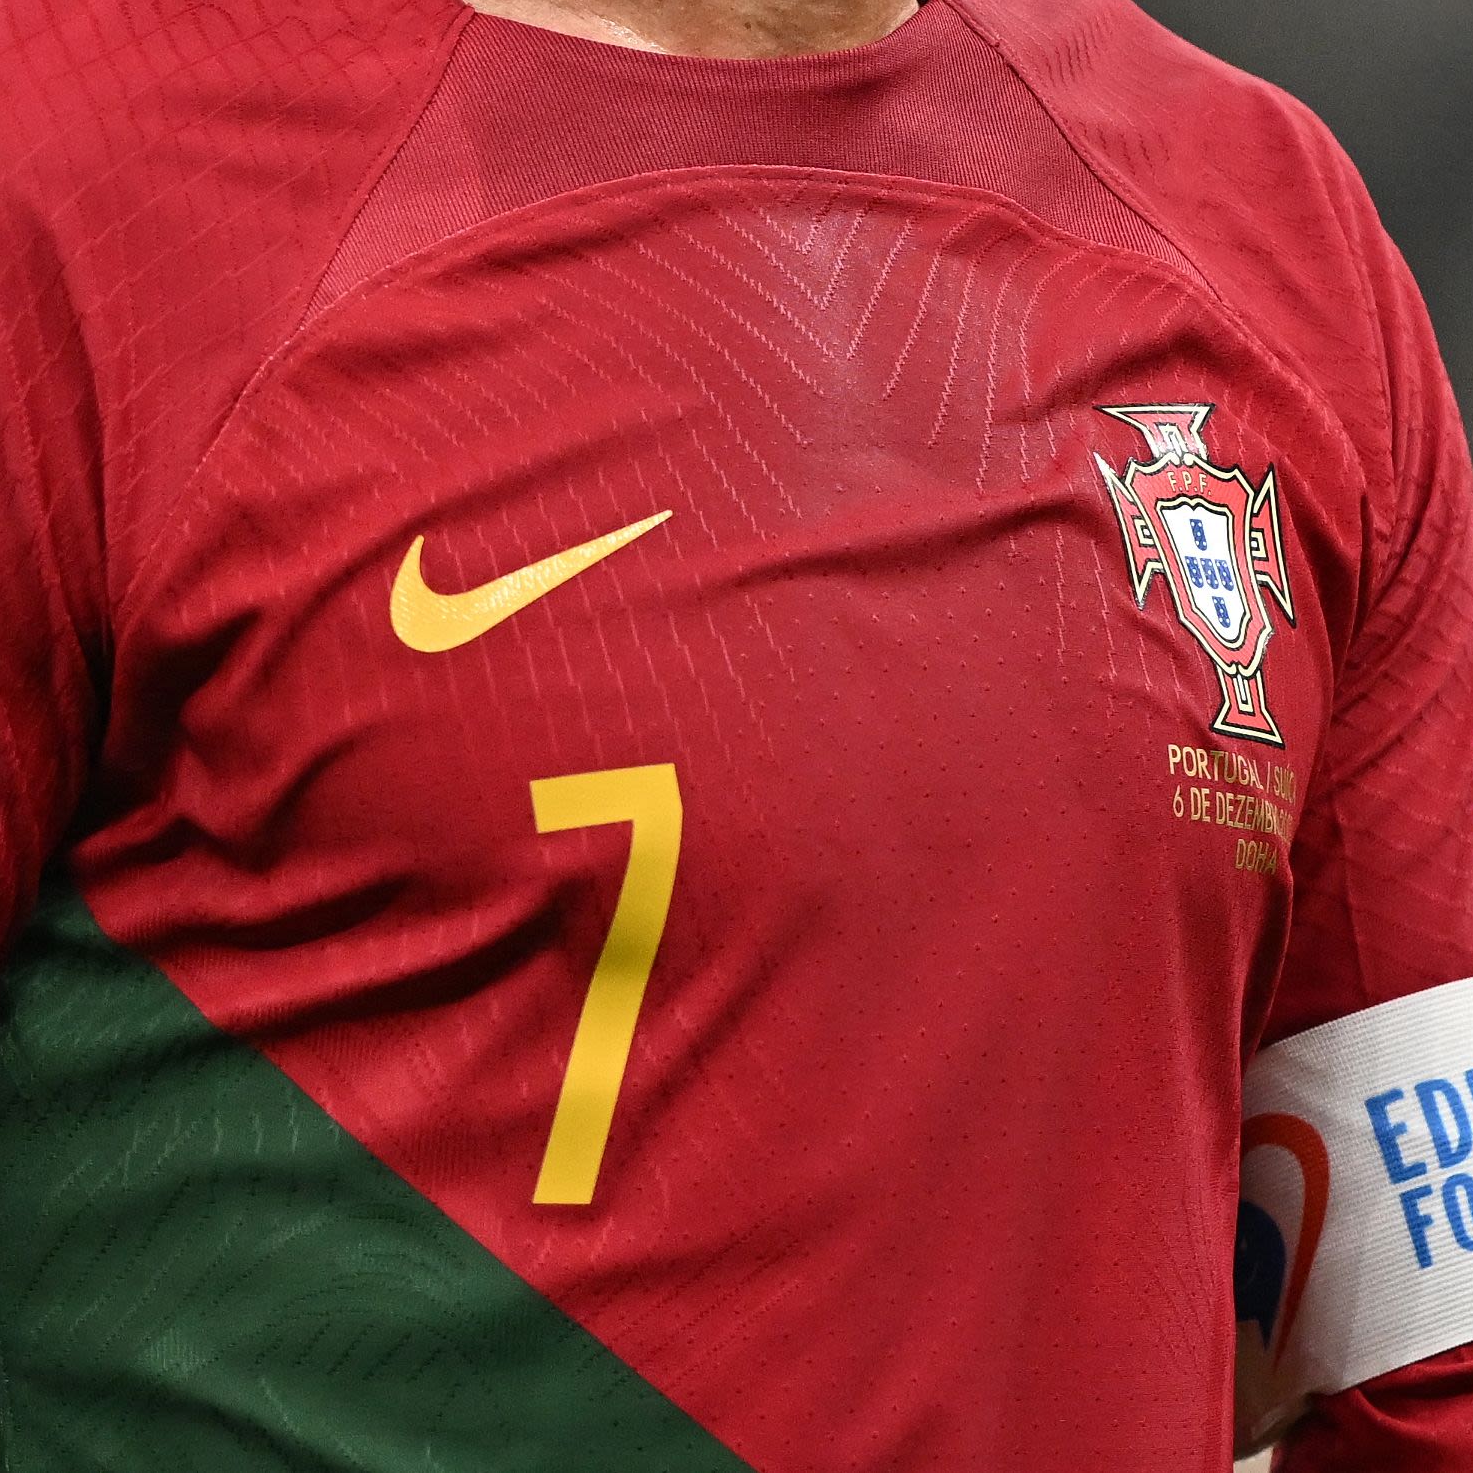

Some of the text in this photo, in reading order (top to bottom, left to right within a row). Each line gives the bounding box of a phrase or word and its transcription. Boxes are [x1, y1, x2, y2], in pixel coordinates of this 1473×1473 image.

[1167, 471, 1211, 496] F.P.F.
[1167, 744, 1264, 790] PORTUGAL
[1173, 785, 1184, 818] 6
[1190, 787, 1211, 823] DE
[1235, 838, 1277, 875] DOHA
[530, 763, 683, 1204] 7
